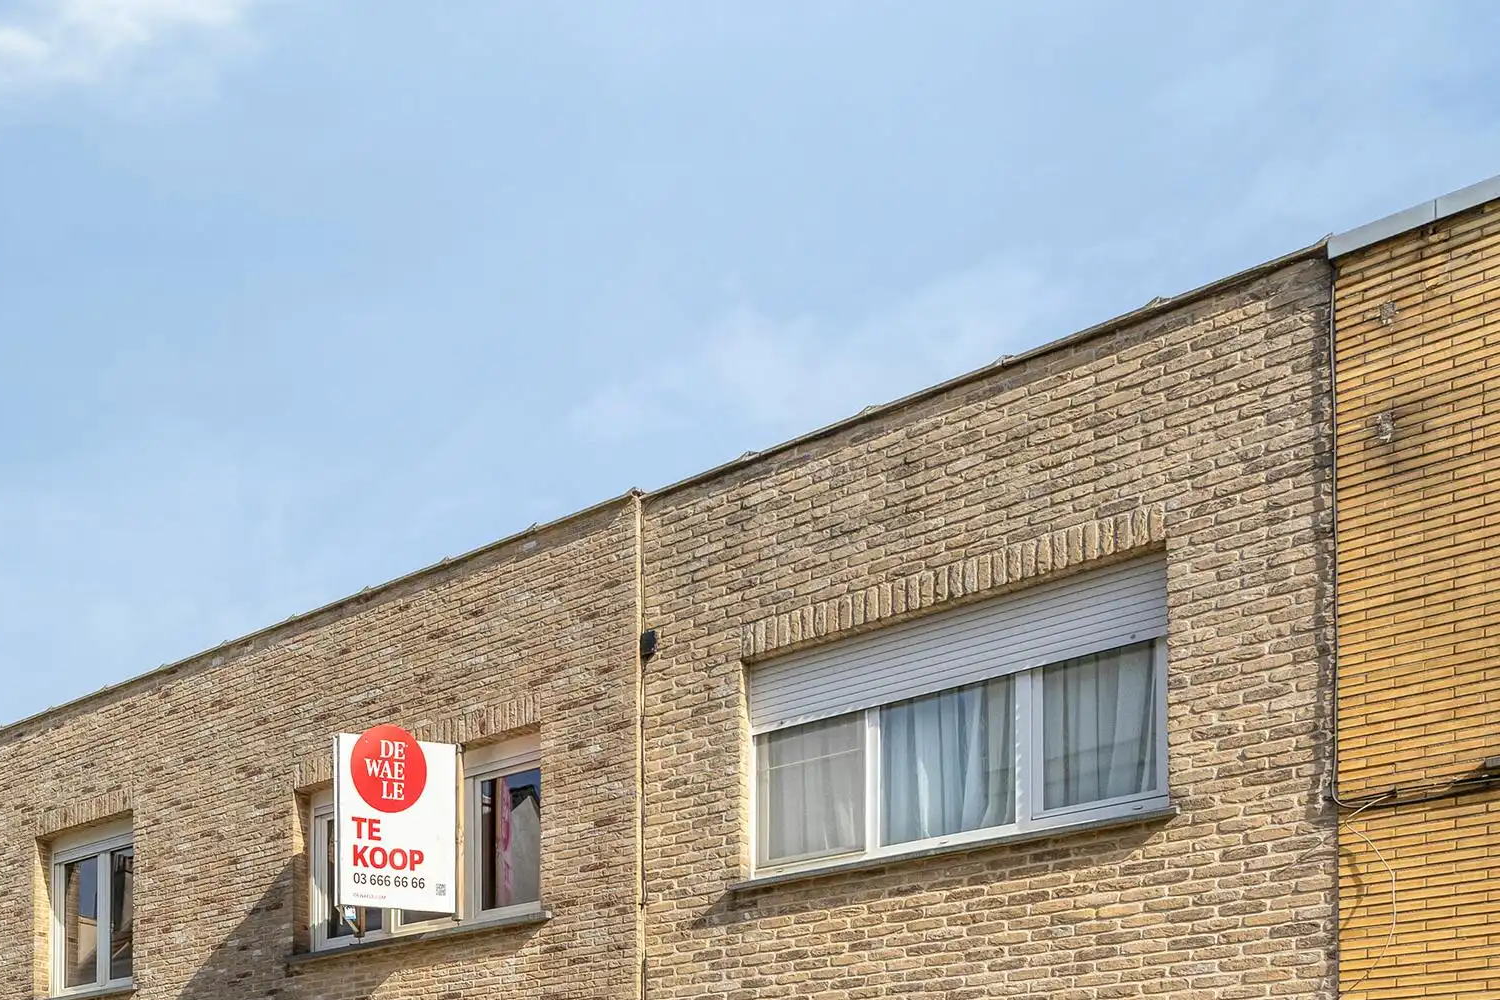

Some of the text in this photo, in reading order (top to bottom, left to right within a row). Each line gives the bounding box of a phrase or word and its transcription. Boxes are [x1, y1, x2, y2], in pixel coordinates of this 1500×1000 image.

[380, 739, 405, 760] DE
[364, 758, 405, 780] WAE
[381, 780, 405, 800] LE
[352, 816, 381, 841] TE
[353, 844, 424, 871] KOOP
[353, 872, 425, 890] 03 666 66 66
